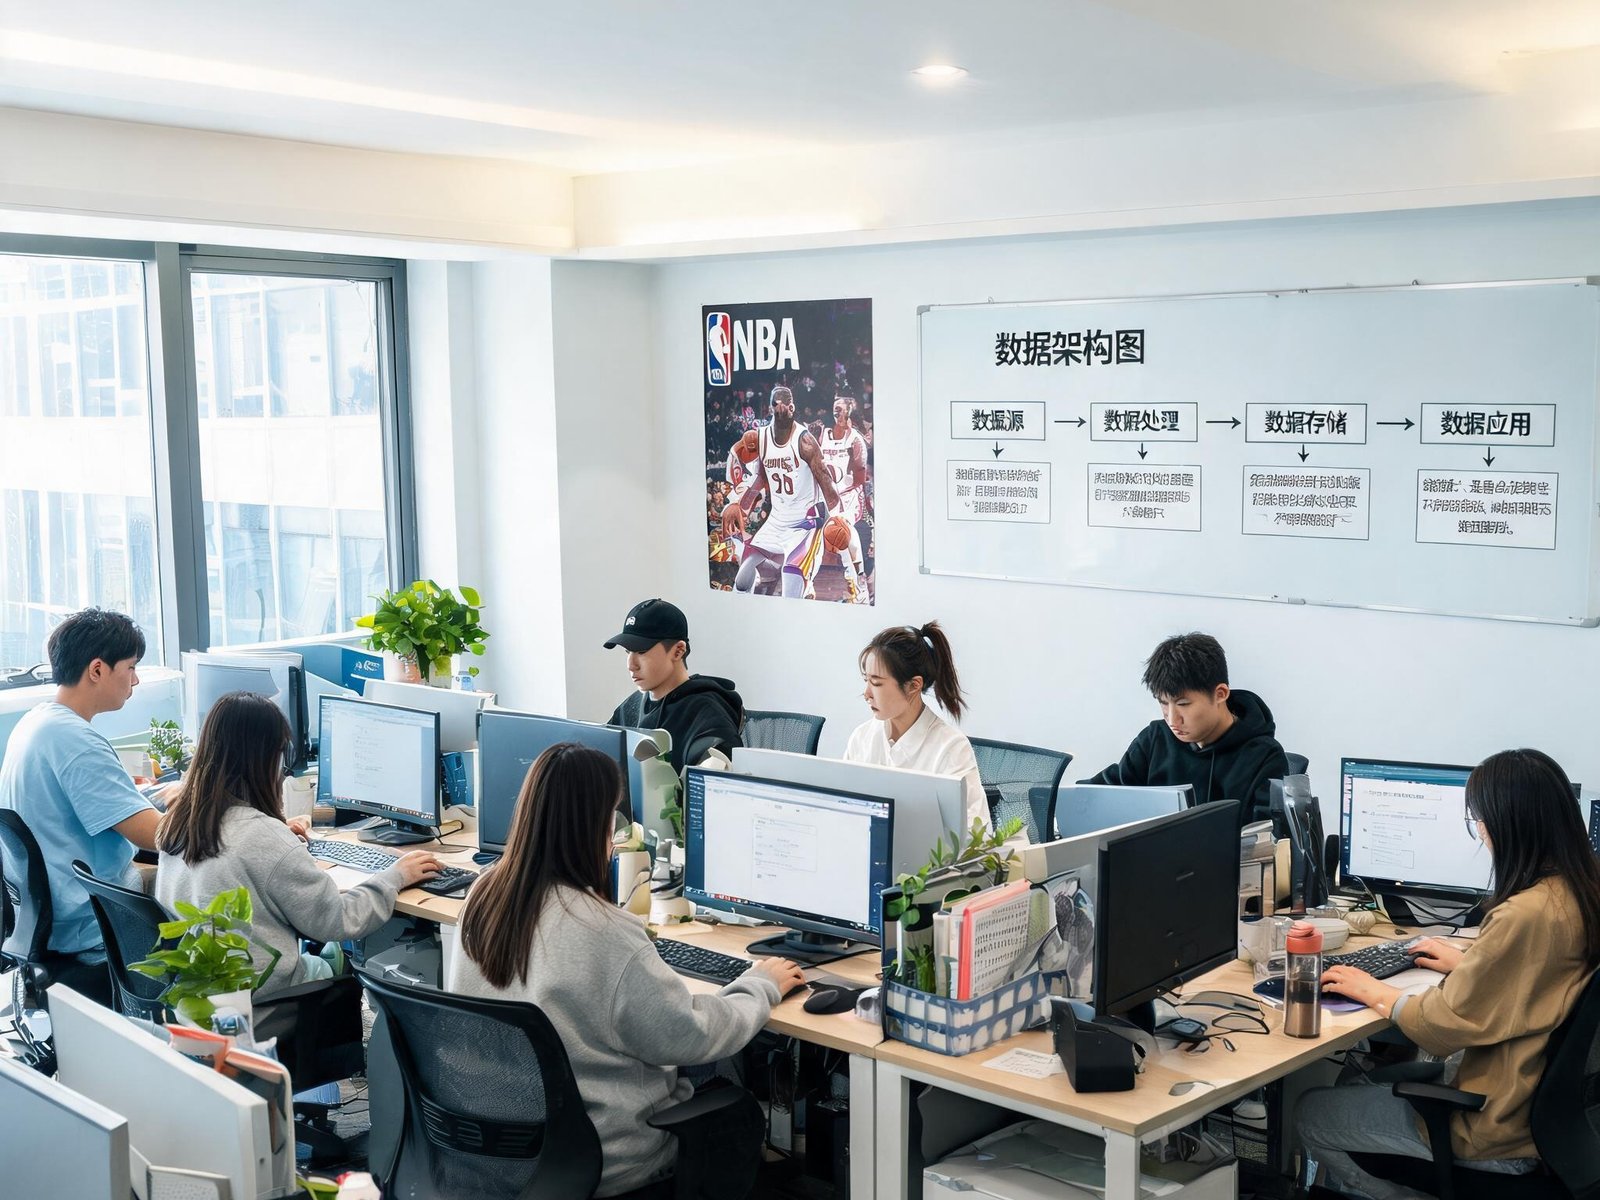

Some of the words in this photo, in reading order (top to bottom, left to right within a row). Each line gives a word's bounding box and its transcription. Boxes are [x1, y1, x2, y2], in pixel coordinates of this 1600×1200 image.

[732, 317, 800, 372] NBA
[994, 328, 1145, 367] 数据架构图
[1103, 408, 1180, 433] 数据处理
[1264, 409, 1348, 436] 数据存储
[1440, 410, 1531, 437] 数据应用
